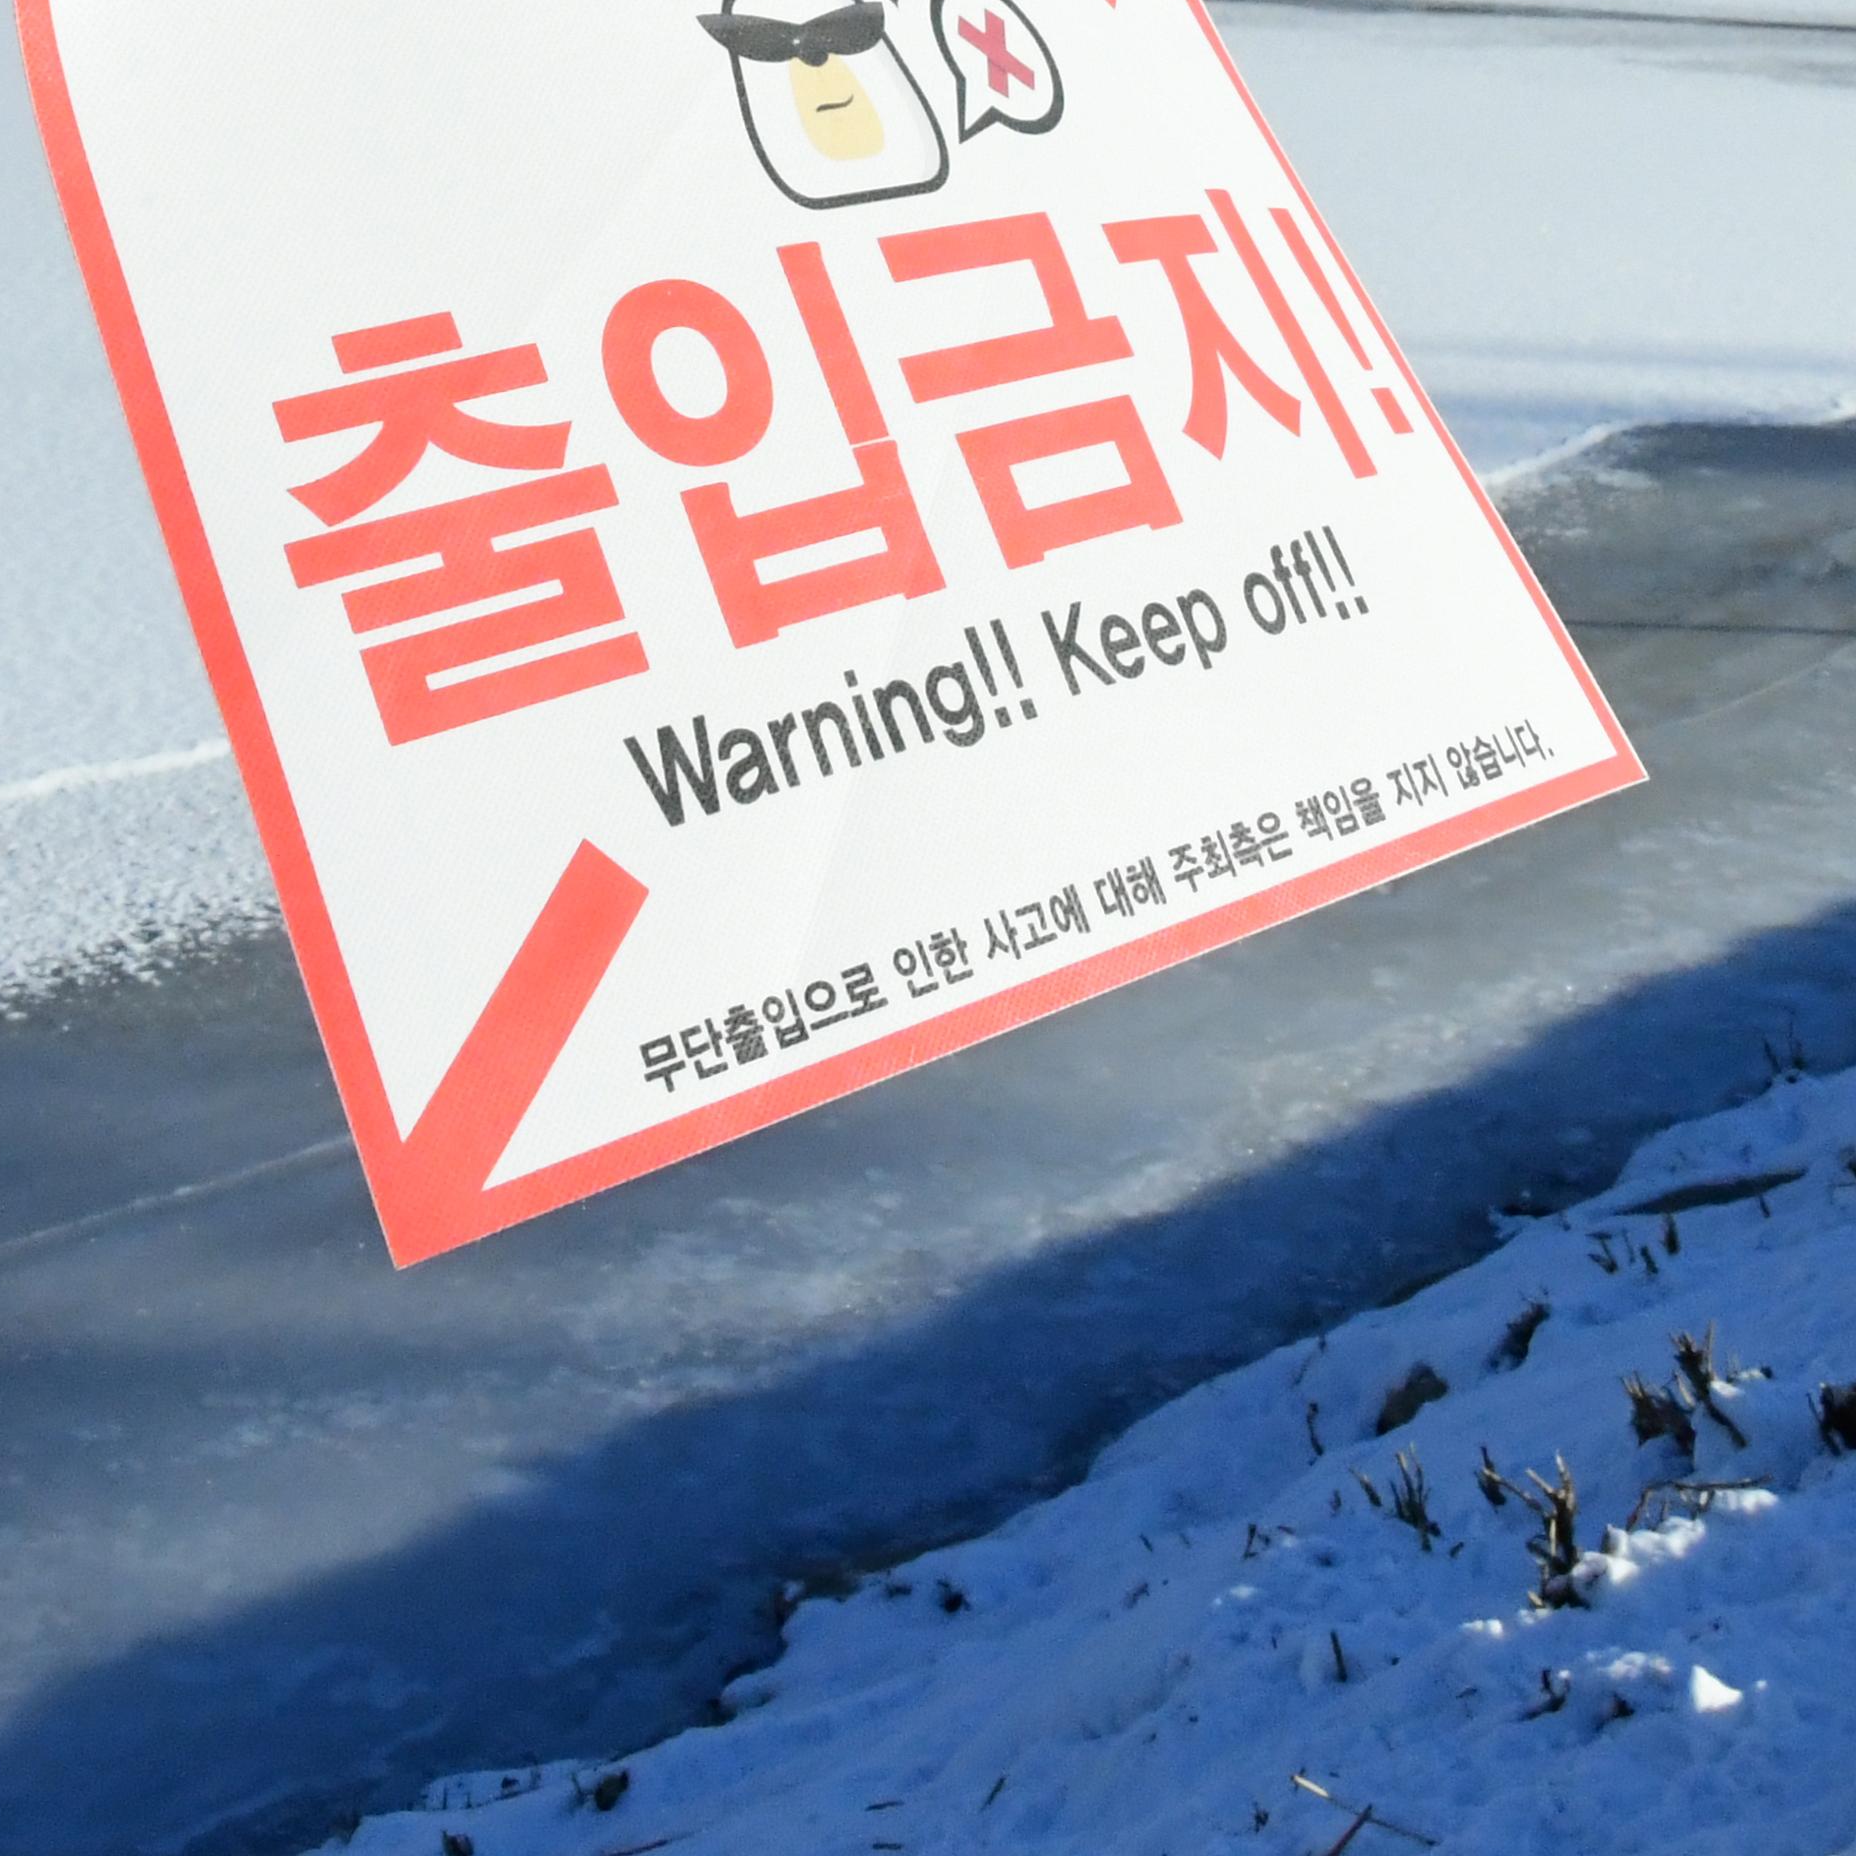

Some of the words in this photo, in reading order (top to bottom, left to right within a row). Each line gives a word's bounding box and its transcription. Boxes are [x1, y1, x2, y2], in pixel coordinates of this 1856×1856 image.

[273, 189, 1414, 747] 출입금지!
[624, 618, 1038, 828] Warning!!
[1040, 588, 1228, 696] Keep
[1243, 525, 1370, 636] off!!
[640, 963, 889, 1093] 무단출입으로
[892, 928, 974, 999] 인한
[983, 884, 1091, 960] 사고에
[1093, 857, 1167, 917] 대해
[1167, 812, 1293, 893] 주최측은
[1294, 778, 1386, 841] 책임을
[1386, 753, 1449, 807] 지지
[1446, 719, 1555, 791] 않습니다.
